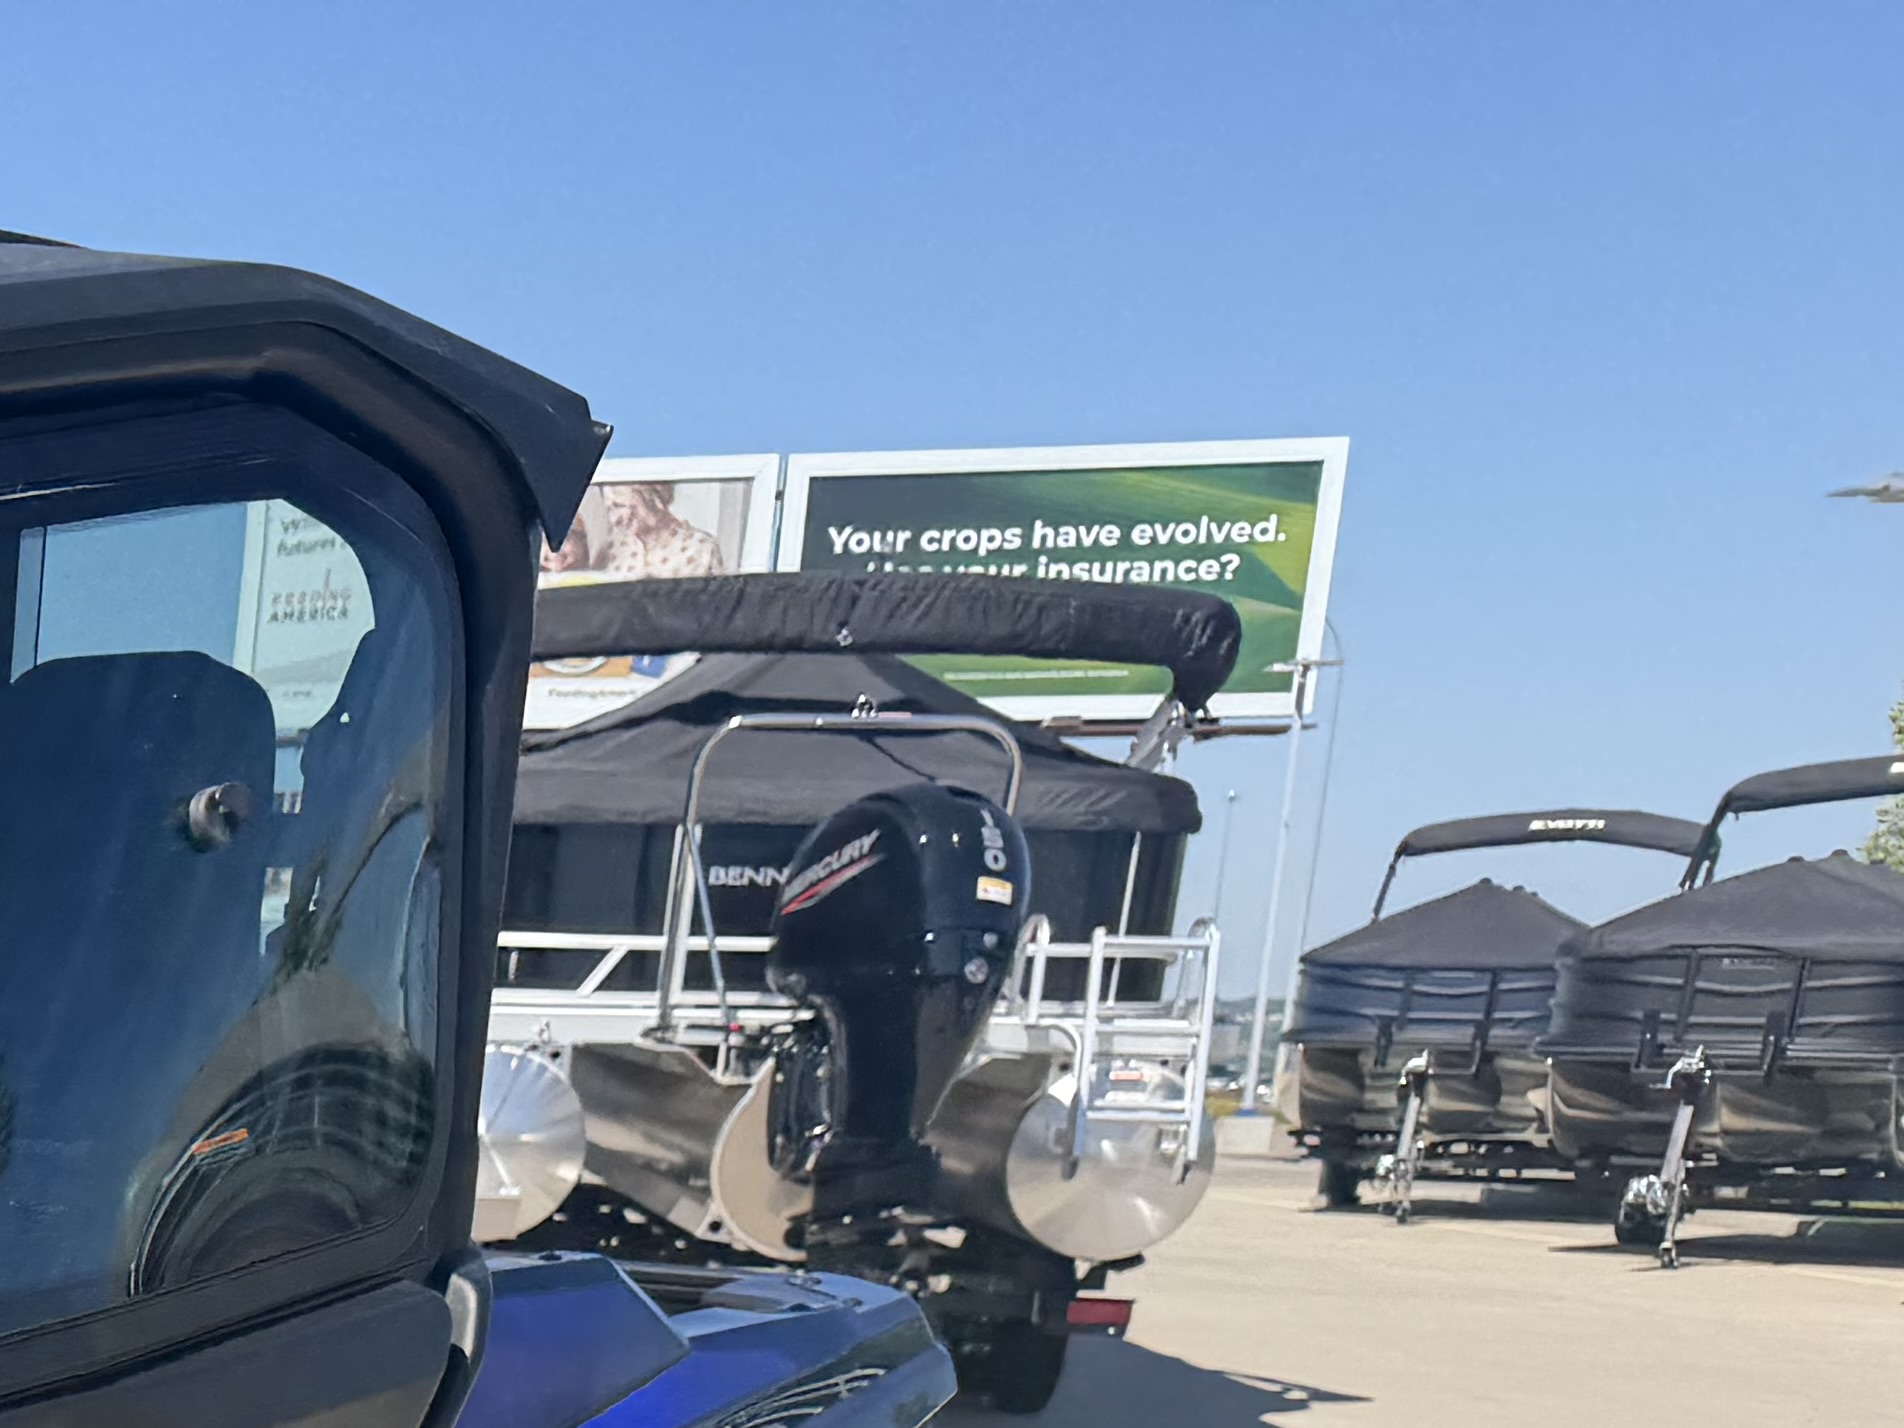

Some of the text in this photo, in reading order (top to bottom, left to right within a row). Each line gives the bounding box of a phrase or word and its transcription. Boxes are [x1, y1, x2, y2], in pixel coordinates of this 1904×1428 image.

[827, 514, 1287, 556] Your crops have evolved.
[1037, 553, 1241, 584] insurance?
